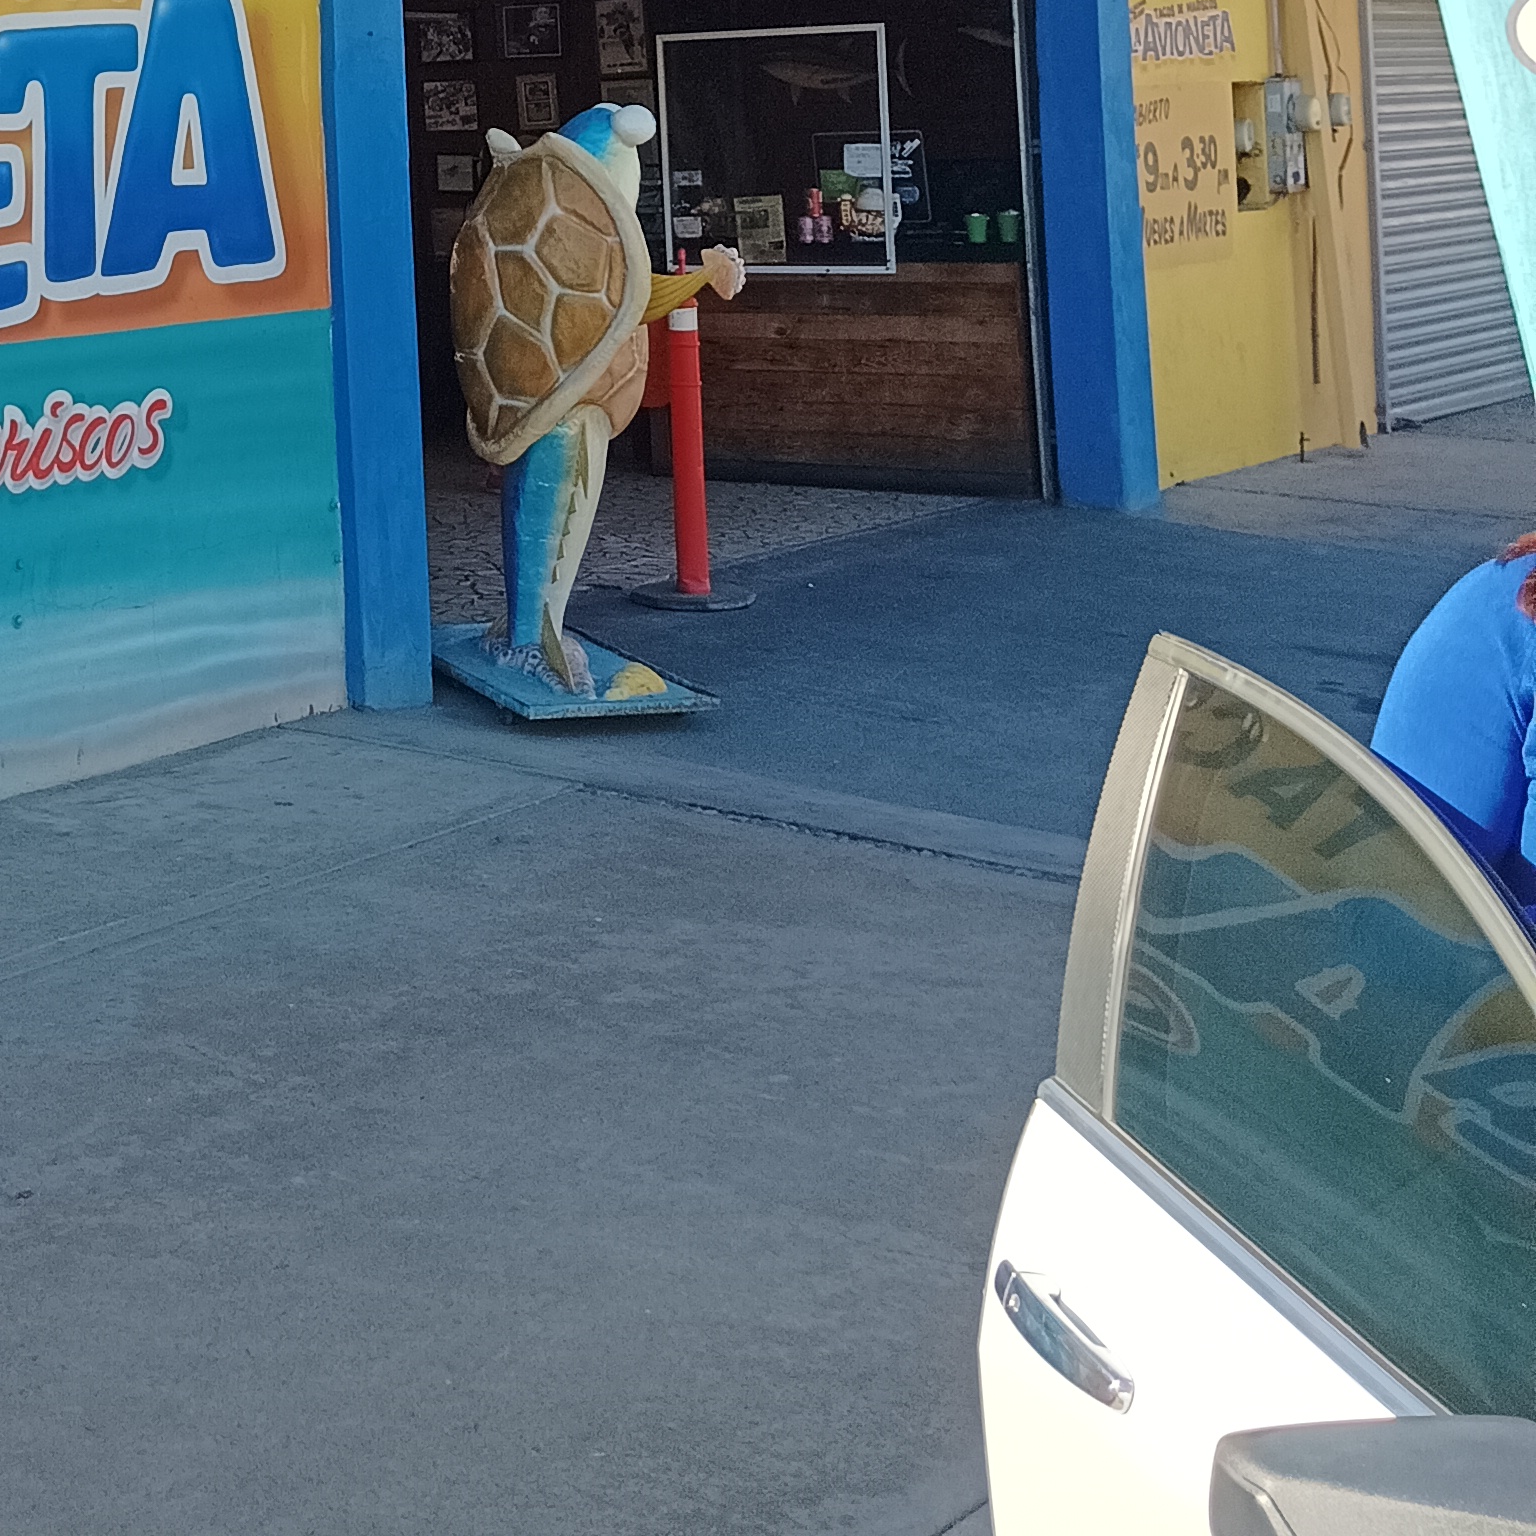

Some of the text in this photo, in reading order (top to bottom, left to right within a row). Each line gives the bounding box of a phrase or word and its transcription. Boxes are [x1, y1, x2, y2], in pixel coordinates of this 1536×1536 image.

[1142, 10, 1235, 61] AVIONETA
[1134, 98, 1170, 126] BIERTO
[1142, 205, 1175, 248] UEVES
